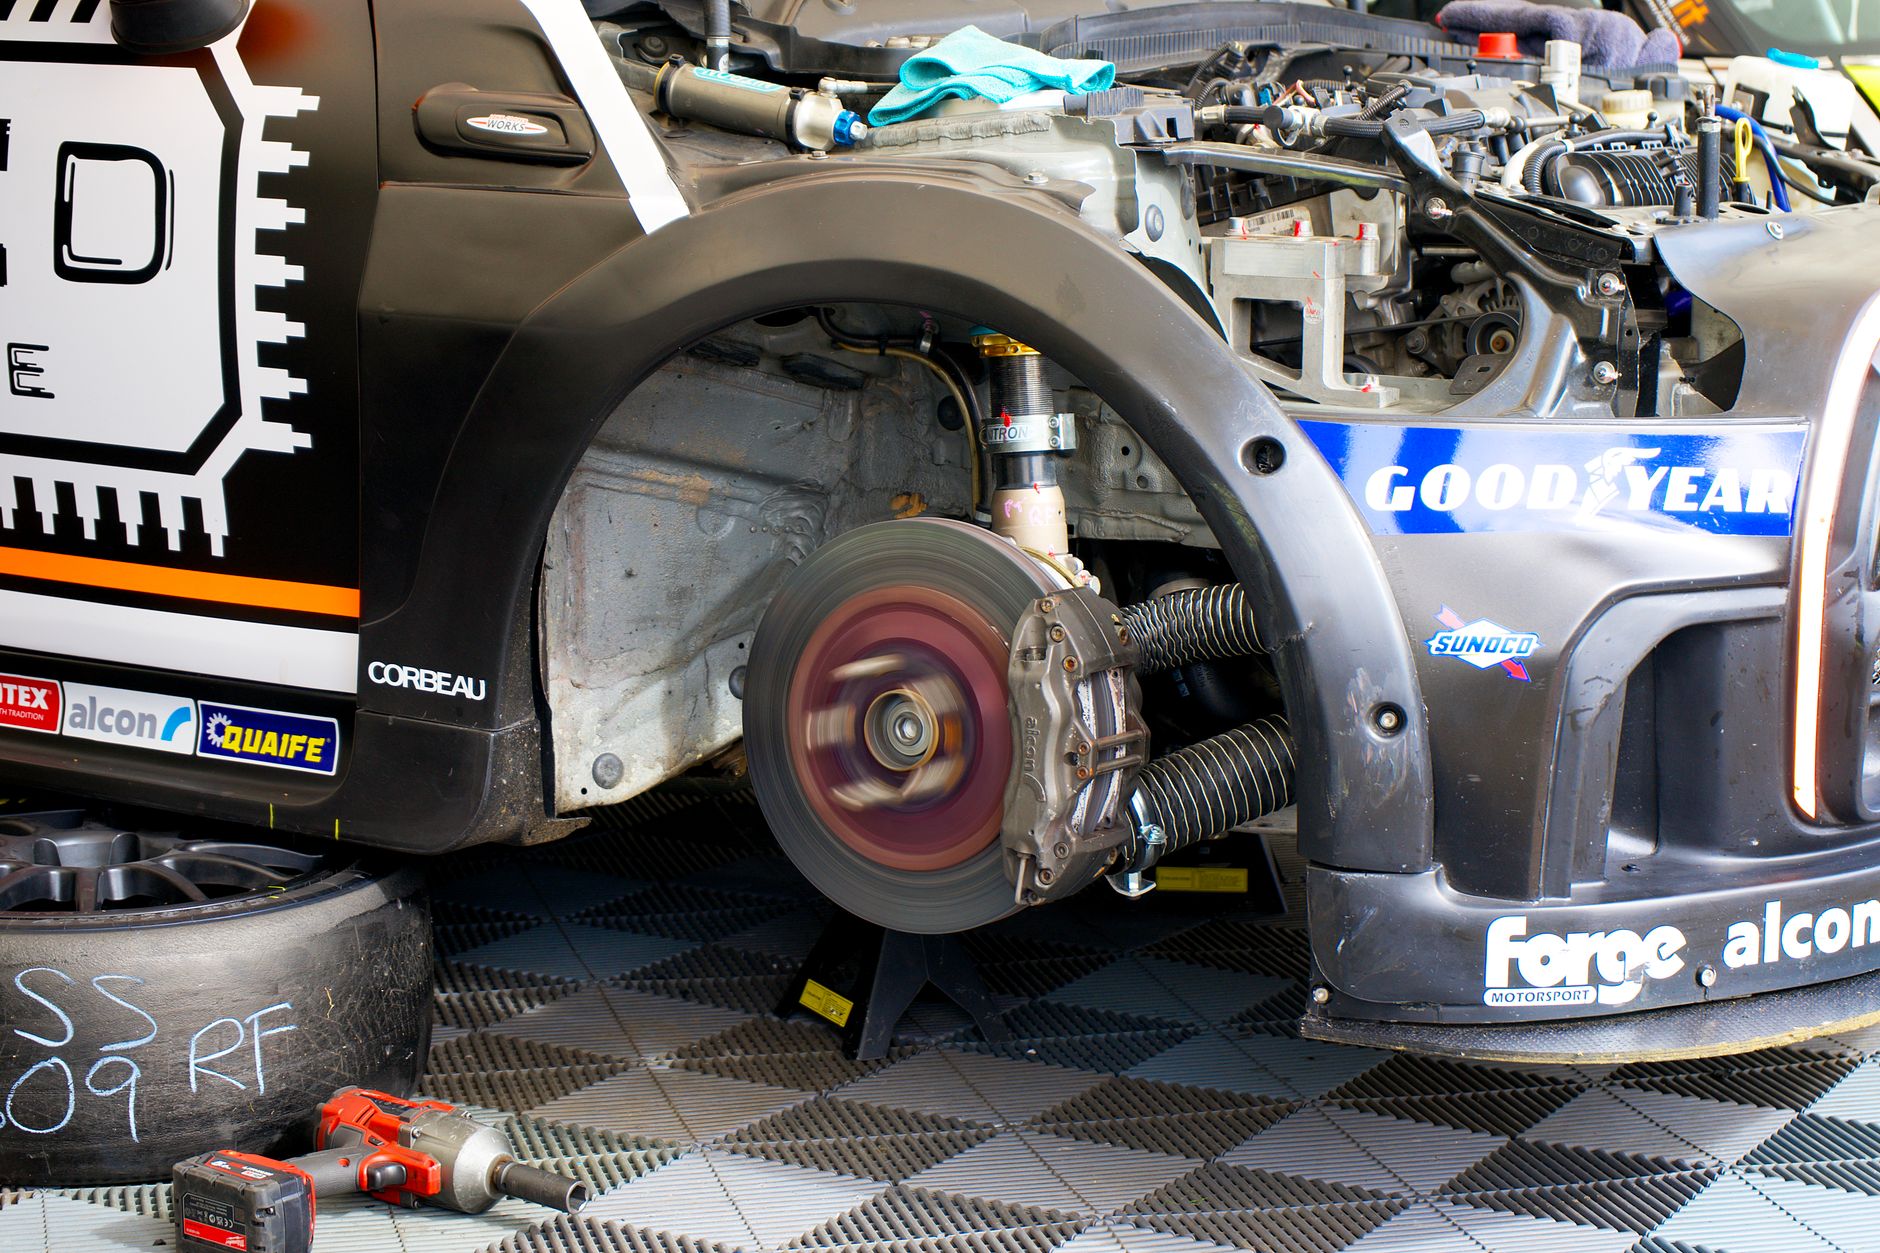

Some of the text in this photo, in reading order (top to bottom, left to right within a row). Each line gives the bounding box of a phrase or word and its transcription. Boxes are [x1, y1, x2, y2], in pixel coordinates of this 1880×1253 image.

[487, 120, 526, 132] WORKS
[1435, 635, 1534, 654] SUNOCO
[368, 661, 486, 701] CORBEAU
[0, 682, 49, 710] TEX
[8, 709, 44, 721] TRADITION
[69, 696, 158, 740] alcon
[222, 725, 326, 763] QUAIFE
[1722, 899, 1880, 969] alcon
[1491, 989, 1590, 1003] MOTORSPORT
